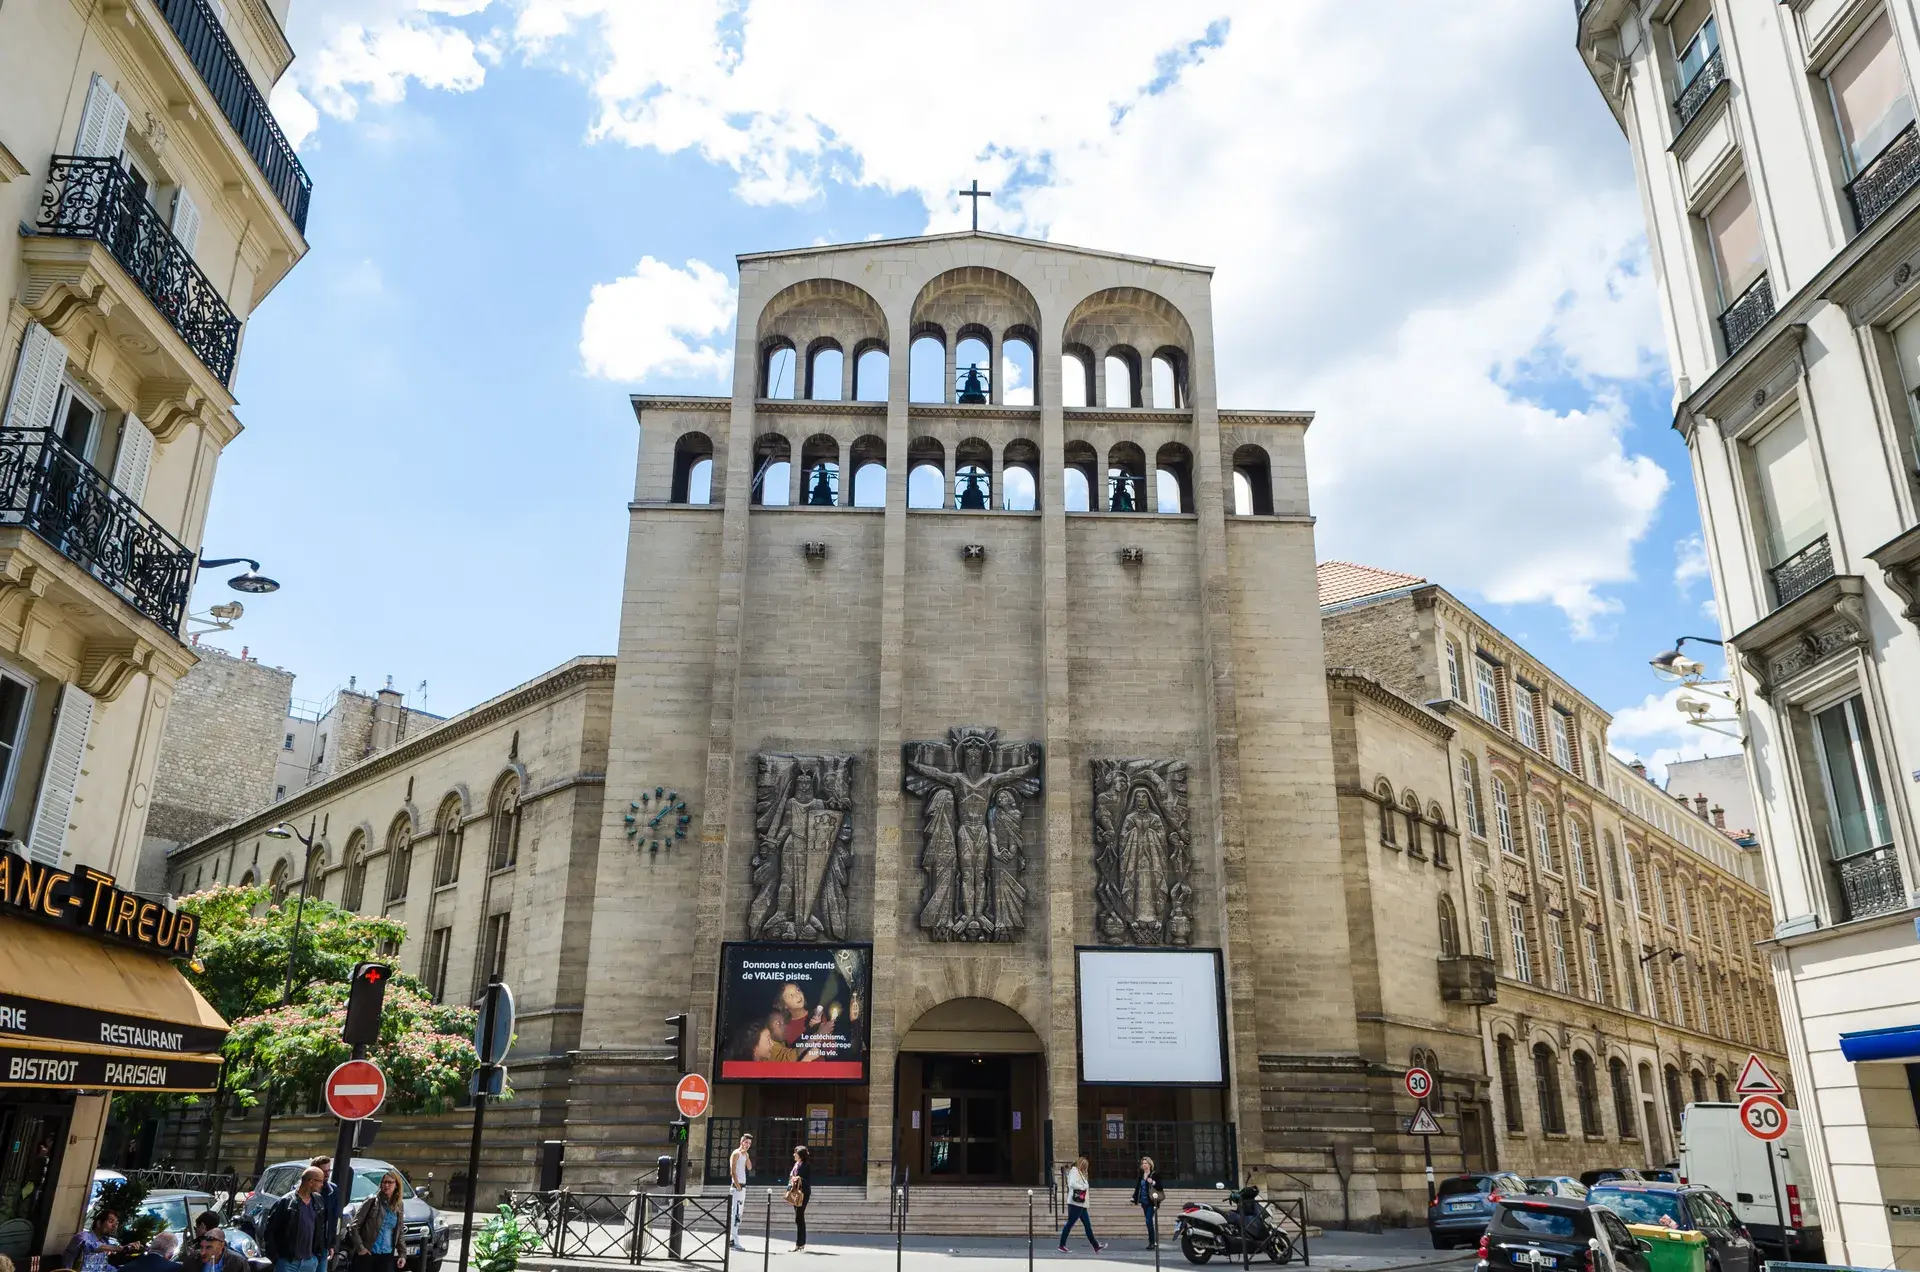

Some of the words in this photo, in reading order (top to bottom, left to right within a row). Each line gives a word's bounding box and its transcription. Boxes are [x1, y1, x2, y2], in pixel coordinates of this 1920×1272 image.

[742, 960, 780, 969] Donnons
[780, 960, 787, 969] à
[804, 961, 836, 970] enfants
[742, 971, 754, 980] de
[754, 971, 785, 980] VRAIES
[785, 972, 813, 982] pistes.
[100, 1022, 184, 1051] RESTAURANT
[809, 1033, 846, 1041] catéchisme,
[822, 1041, 852, 1049] éclairage
[9, 1057, 79, 1082] BISTROT
[104, 1063, 167, 1085] PARISIEN
[1411, 1076, 1426, 1090] 30
[1749, 1108, 1779, 1128] 30
